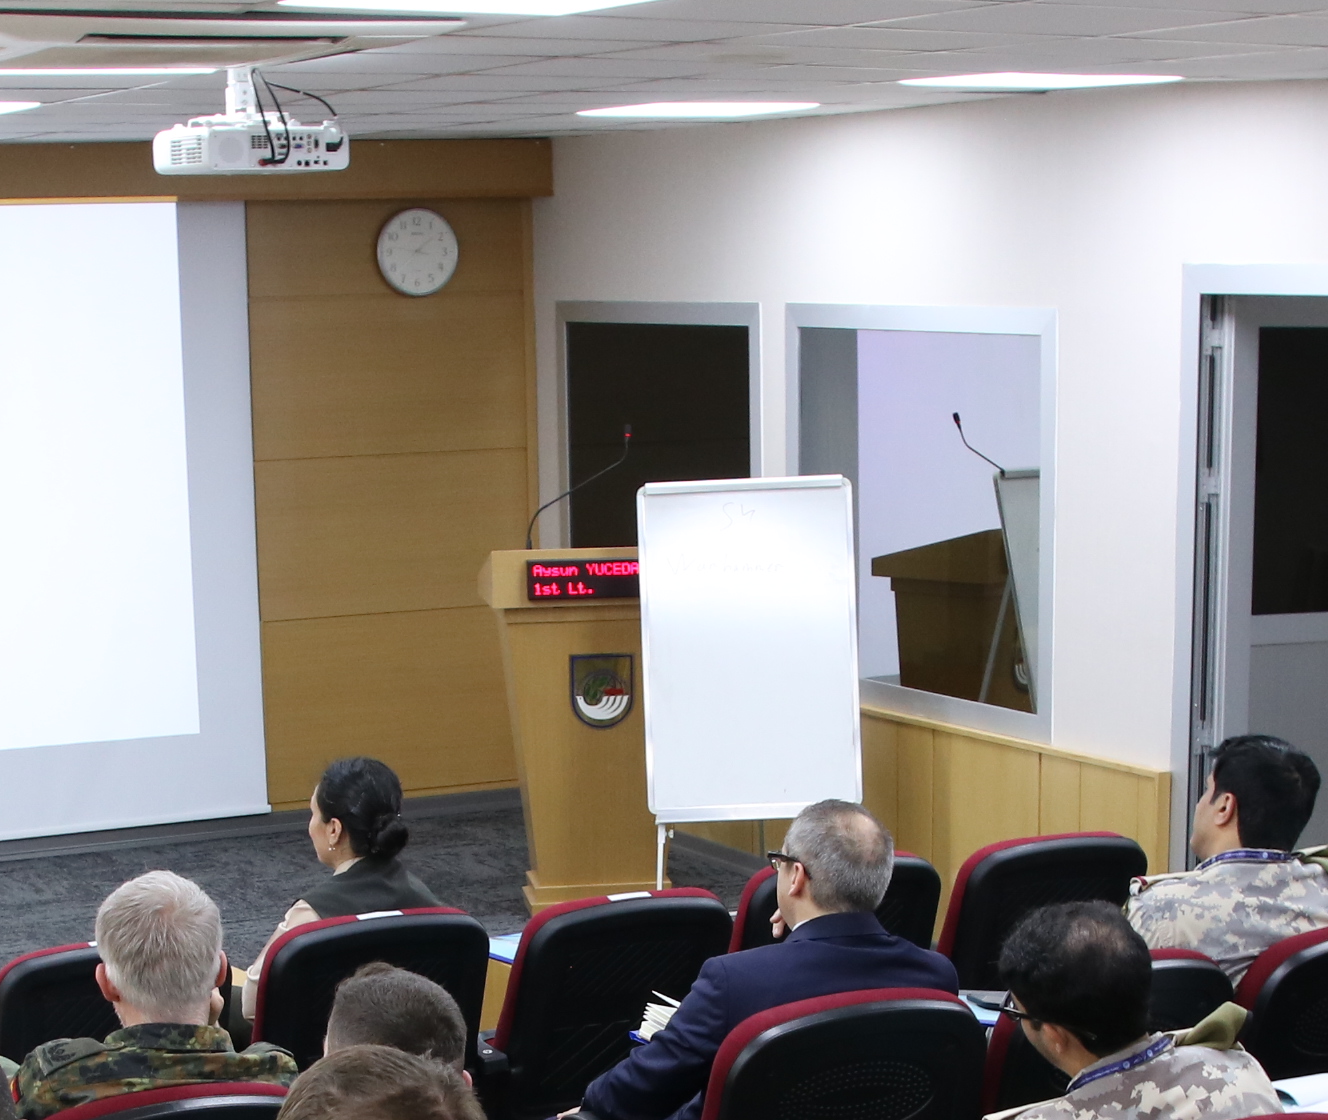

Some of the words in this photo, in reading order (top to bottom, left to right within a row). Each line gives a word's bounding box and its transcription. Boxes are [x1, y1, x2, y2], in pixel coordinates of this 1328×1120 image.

[532, 564, 580, 578] Aysun
[586, 561, 640, 577] YUCEDA
[534, 582, 561, 596] 1st
[568, 581, 595, 595] Lt.
